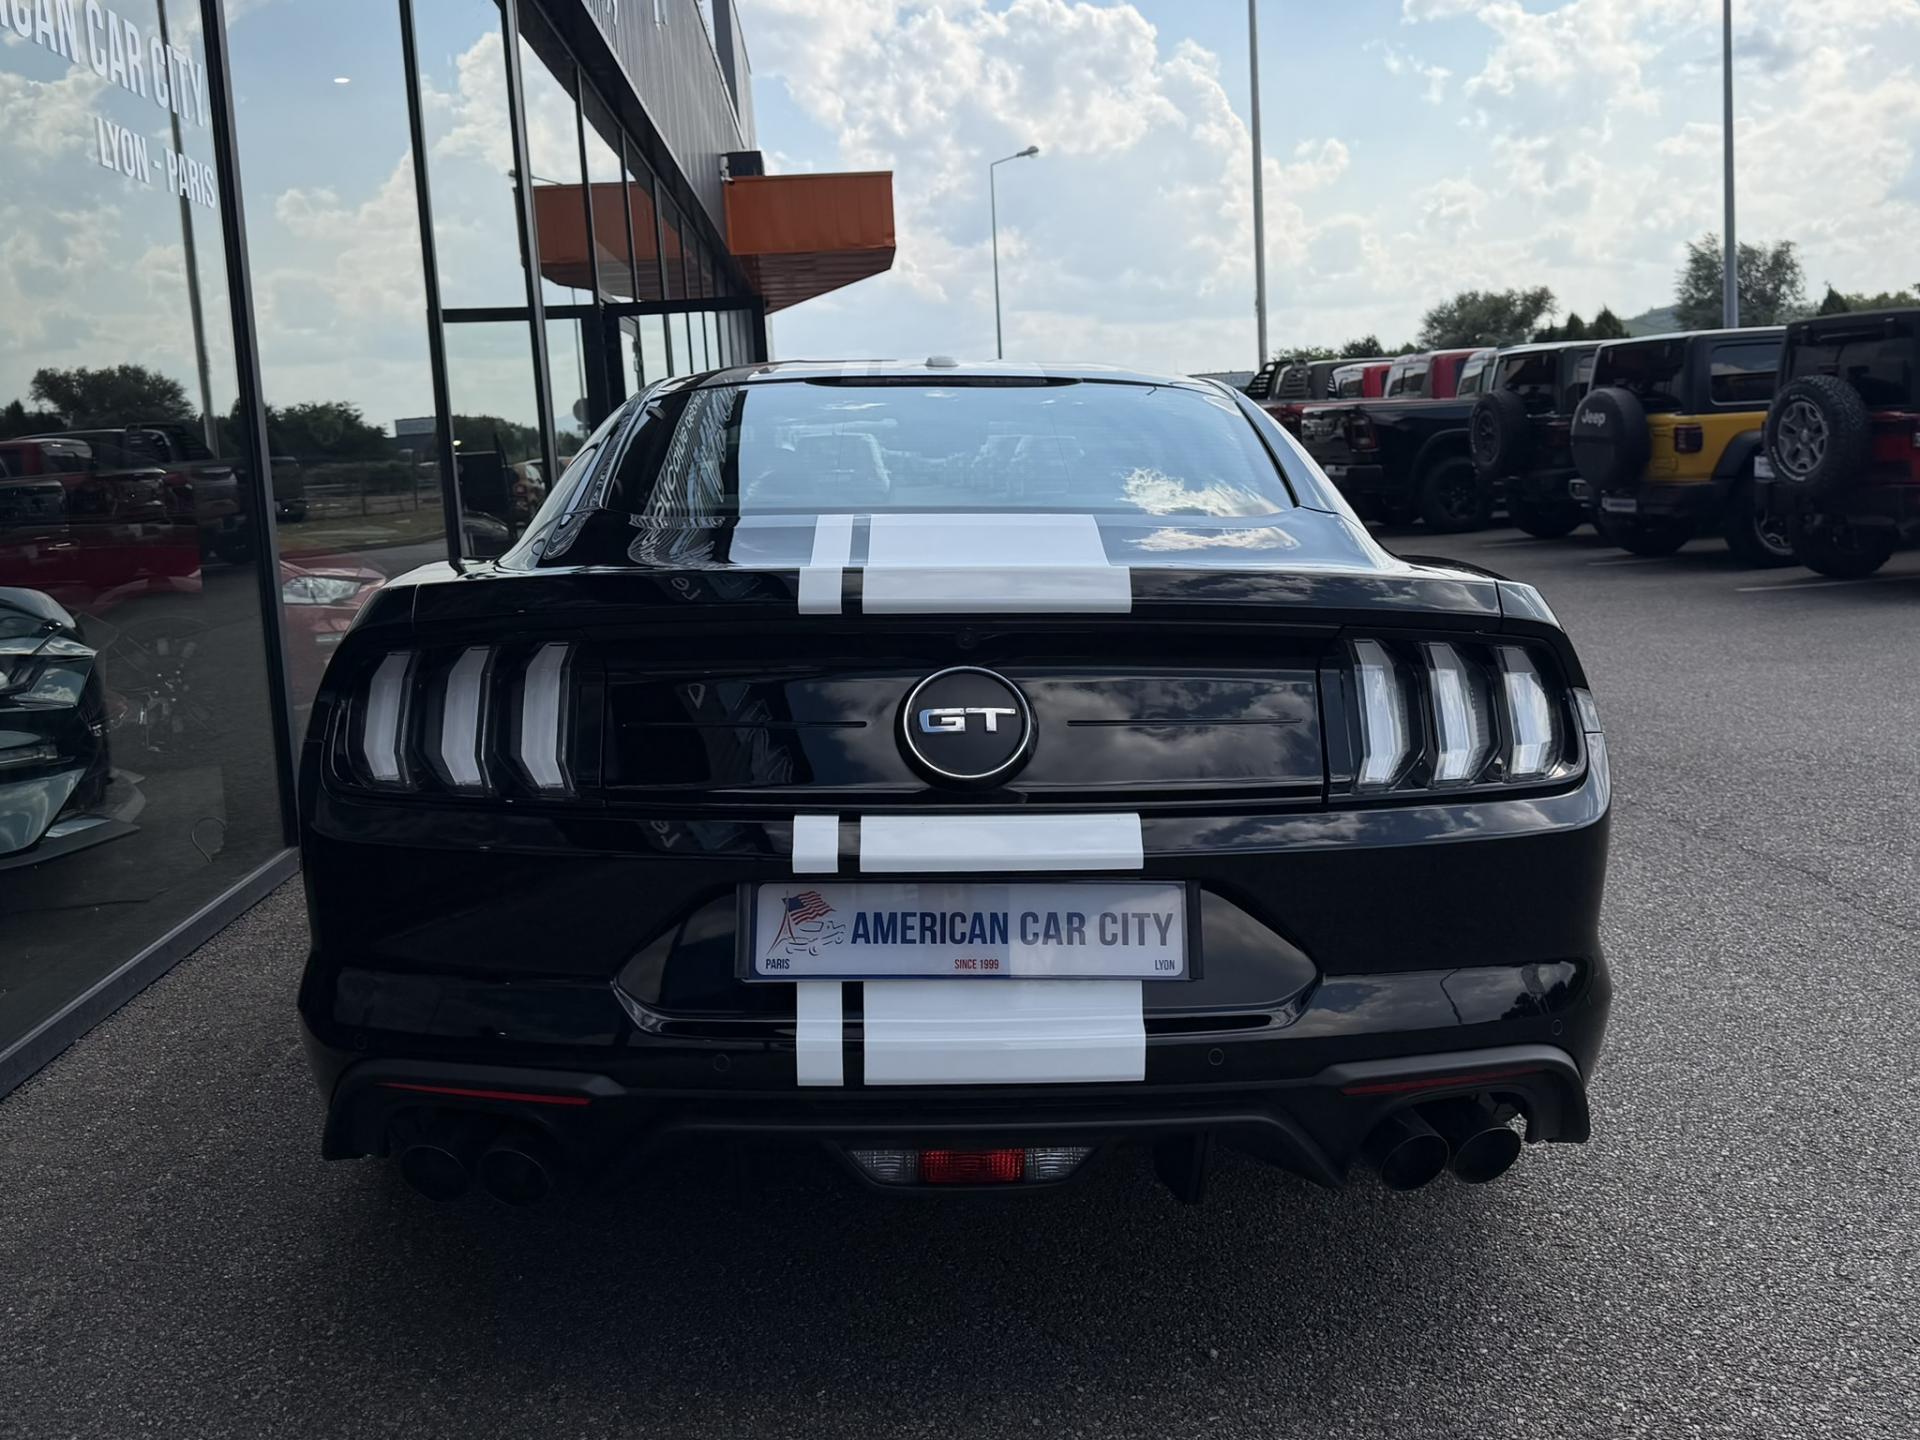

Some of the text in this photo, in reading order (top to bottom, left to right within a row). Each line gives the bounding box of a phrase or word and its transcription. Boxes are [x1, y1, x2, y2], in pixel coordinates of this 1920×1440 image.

[84, 0, 147, 98] CAR
[149, 36, 204, 127] CITY
[95, 116, 150, 184] LYON
[163, 148, 216, 209] PARIS
[1581, 408, 1606, 428] Jeep
[918, 706, 1017, 733] GT
[850, 911, 1174, 946] AMERICAN CAR CITY
[765, 958, 790, 970] PARIS
[954, 958, 999, 970] SINCE 1999
[1154, 959, 1175, 971] LYON
